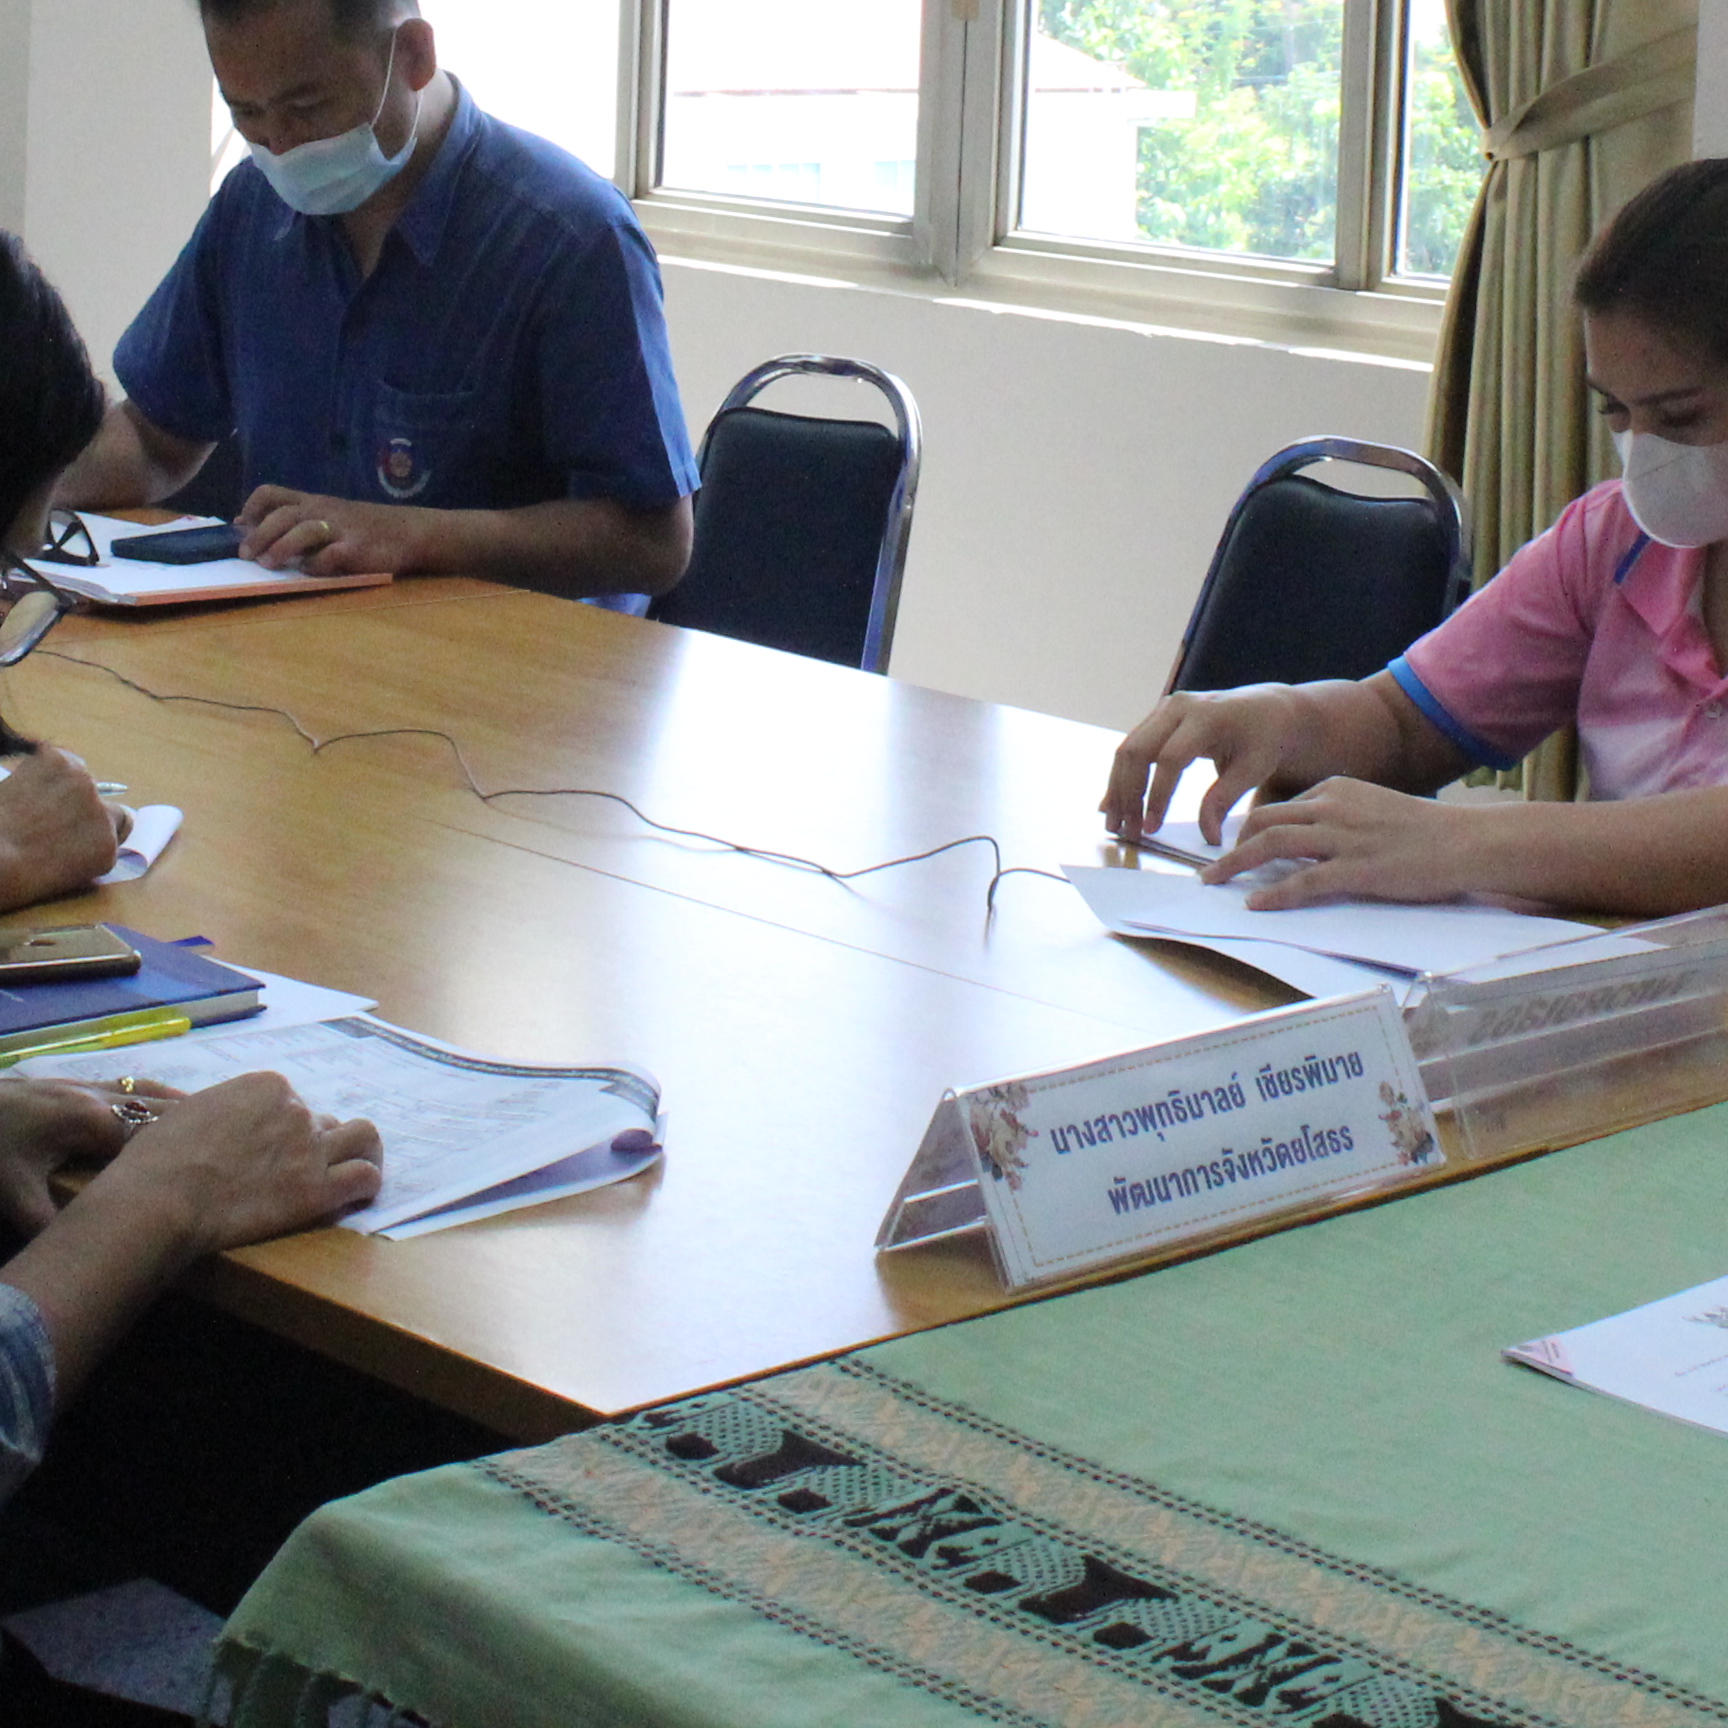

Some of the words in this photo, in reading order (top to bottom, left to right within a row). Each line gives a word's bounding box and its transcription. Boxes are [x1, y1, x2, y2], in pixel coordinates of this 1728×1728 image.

[1049, 1072, 1246, 1156] นางสาวพุทธิมาลย์
[1107, 1124, 1355, 1216] พัฒนาการจังหวัดยโสธร
